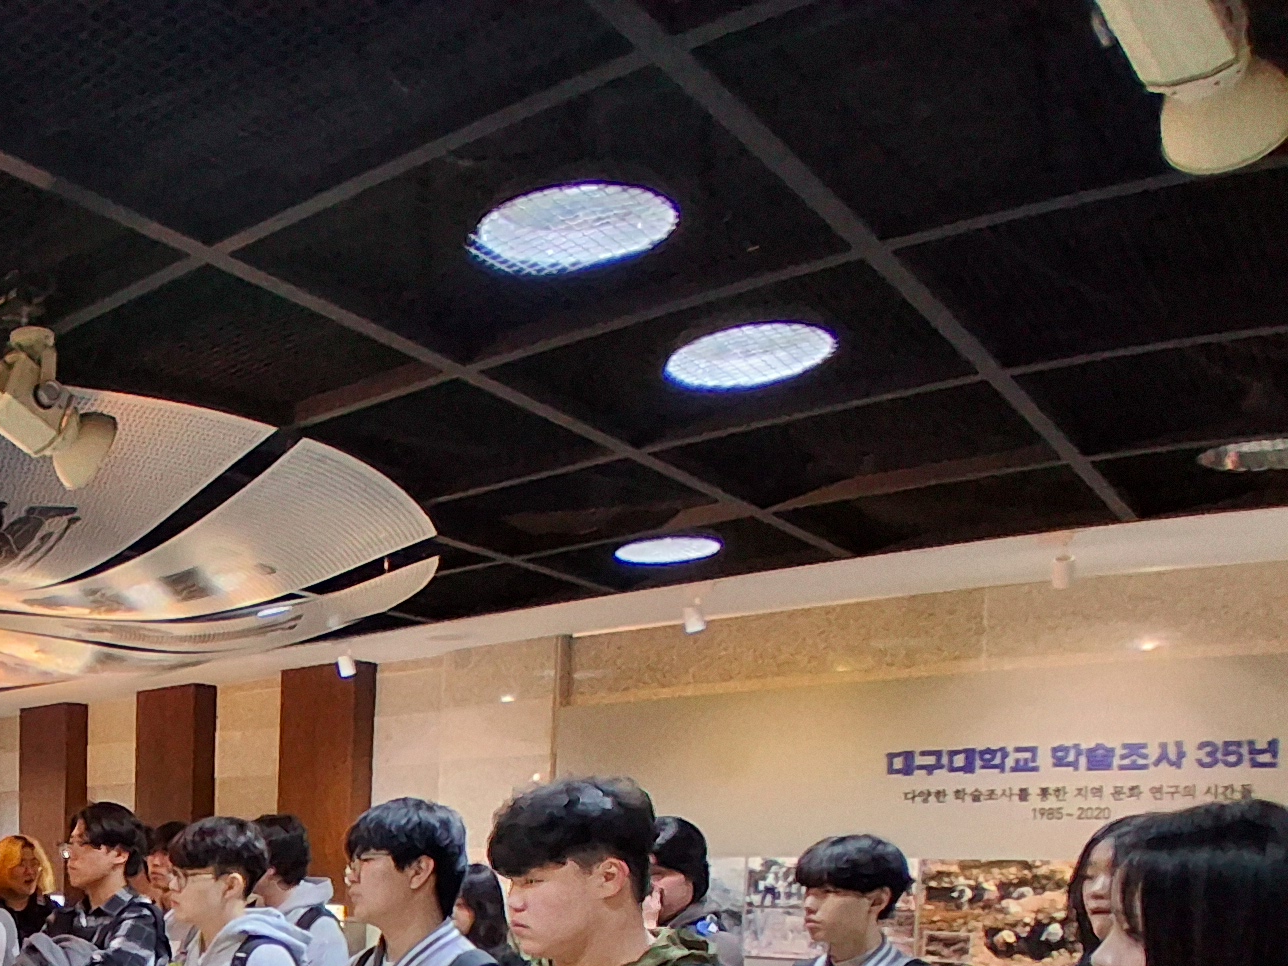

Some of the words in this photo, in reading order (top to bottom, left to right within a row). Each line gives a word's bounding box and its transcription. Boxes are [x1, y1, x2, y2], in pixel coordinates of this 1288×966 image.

[885, 746, 1040, 776] 대구대학교
[1050, 740, 1187, 771] 학술조사
[1194, 738, 1280, 769] 35년
[902, 787, 948, 803] 다양한
[953, 786, 1031, 803] 학술조사를
[1036, 785, 1068, 802] 통한
[1073, 785, 1104, 801] 지역
[1109, 785, 1144, 801] 문화
[1148, 784, 1197, 801] 연구의
